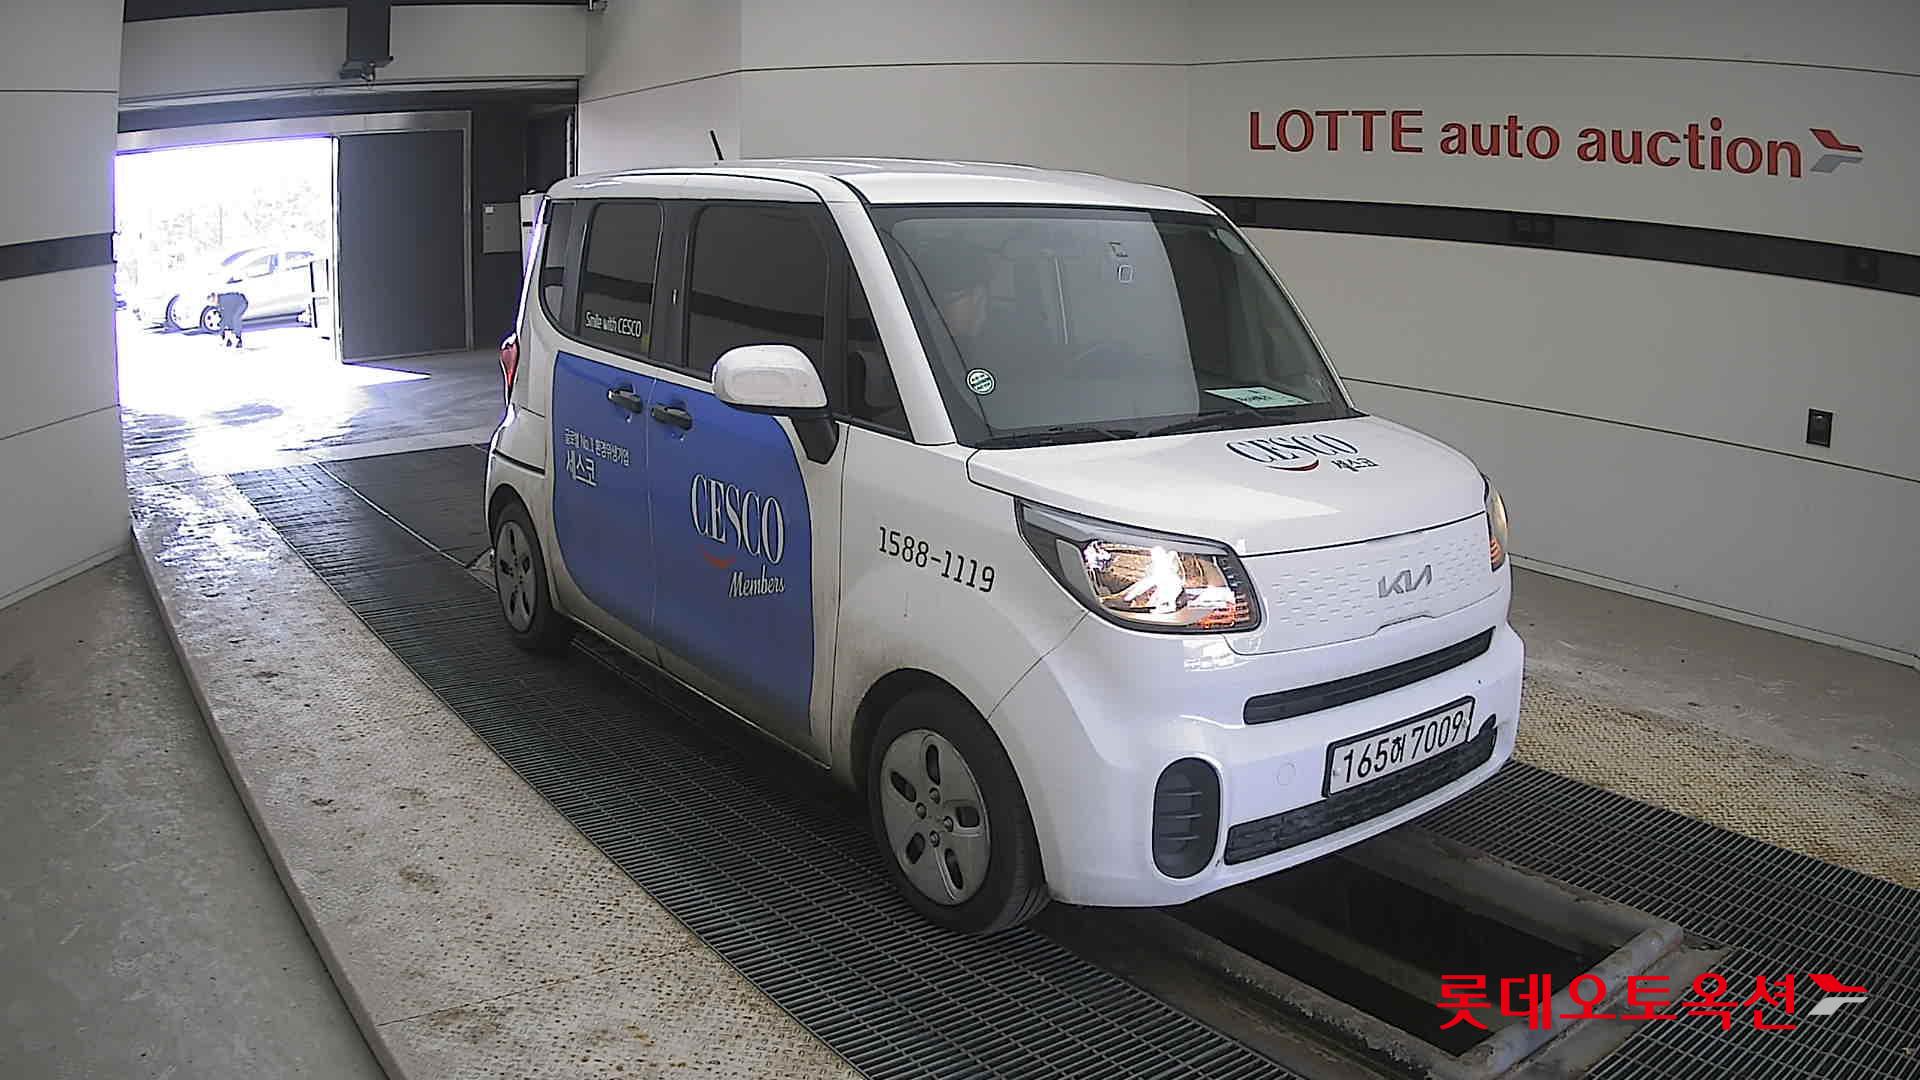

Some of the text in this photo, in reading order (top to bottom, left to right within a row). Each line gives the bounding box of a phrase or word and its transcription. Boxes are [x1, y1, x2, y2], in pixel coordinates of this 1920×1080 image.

[1249, 109, 1803, 179] LOTTE auto auction
[618, 317, 642, 338] CESCO
[566, 449, 598, 487] 세스코
[1226, 433, 1358, 463] CESCO
[690, 474, 785, 564] CESCO
[728, 565, 785, 598] Members
[879, 526, 995, 593] 1588-1119
[1411, 710, 1464, 760] 7009
